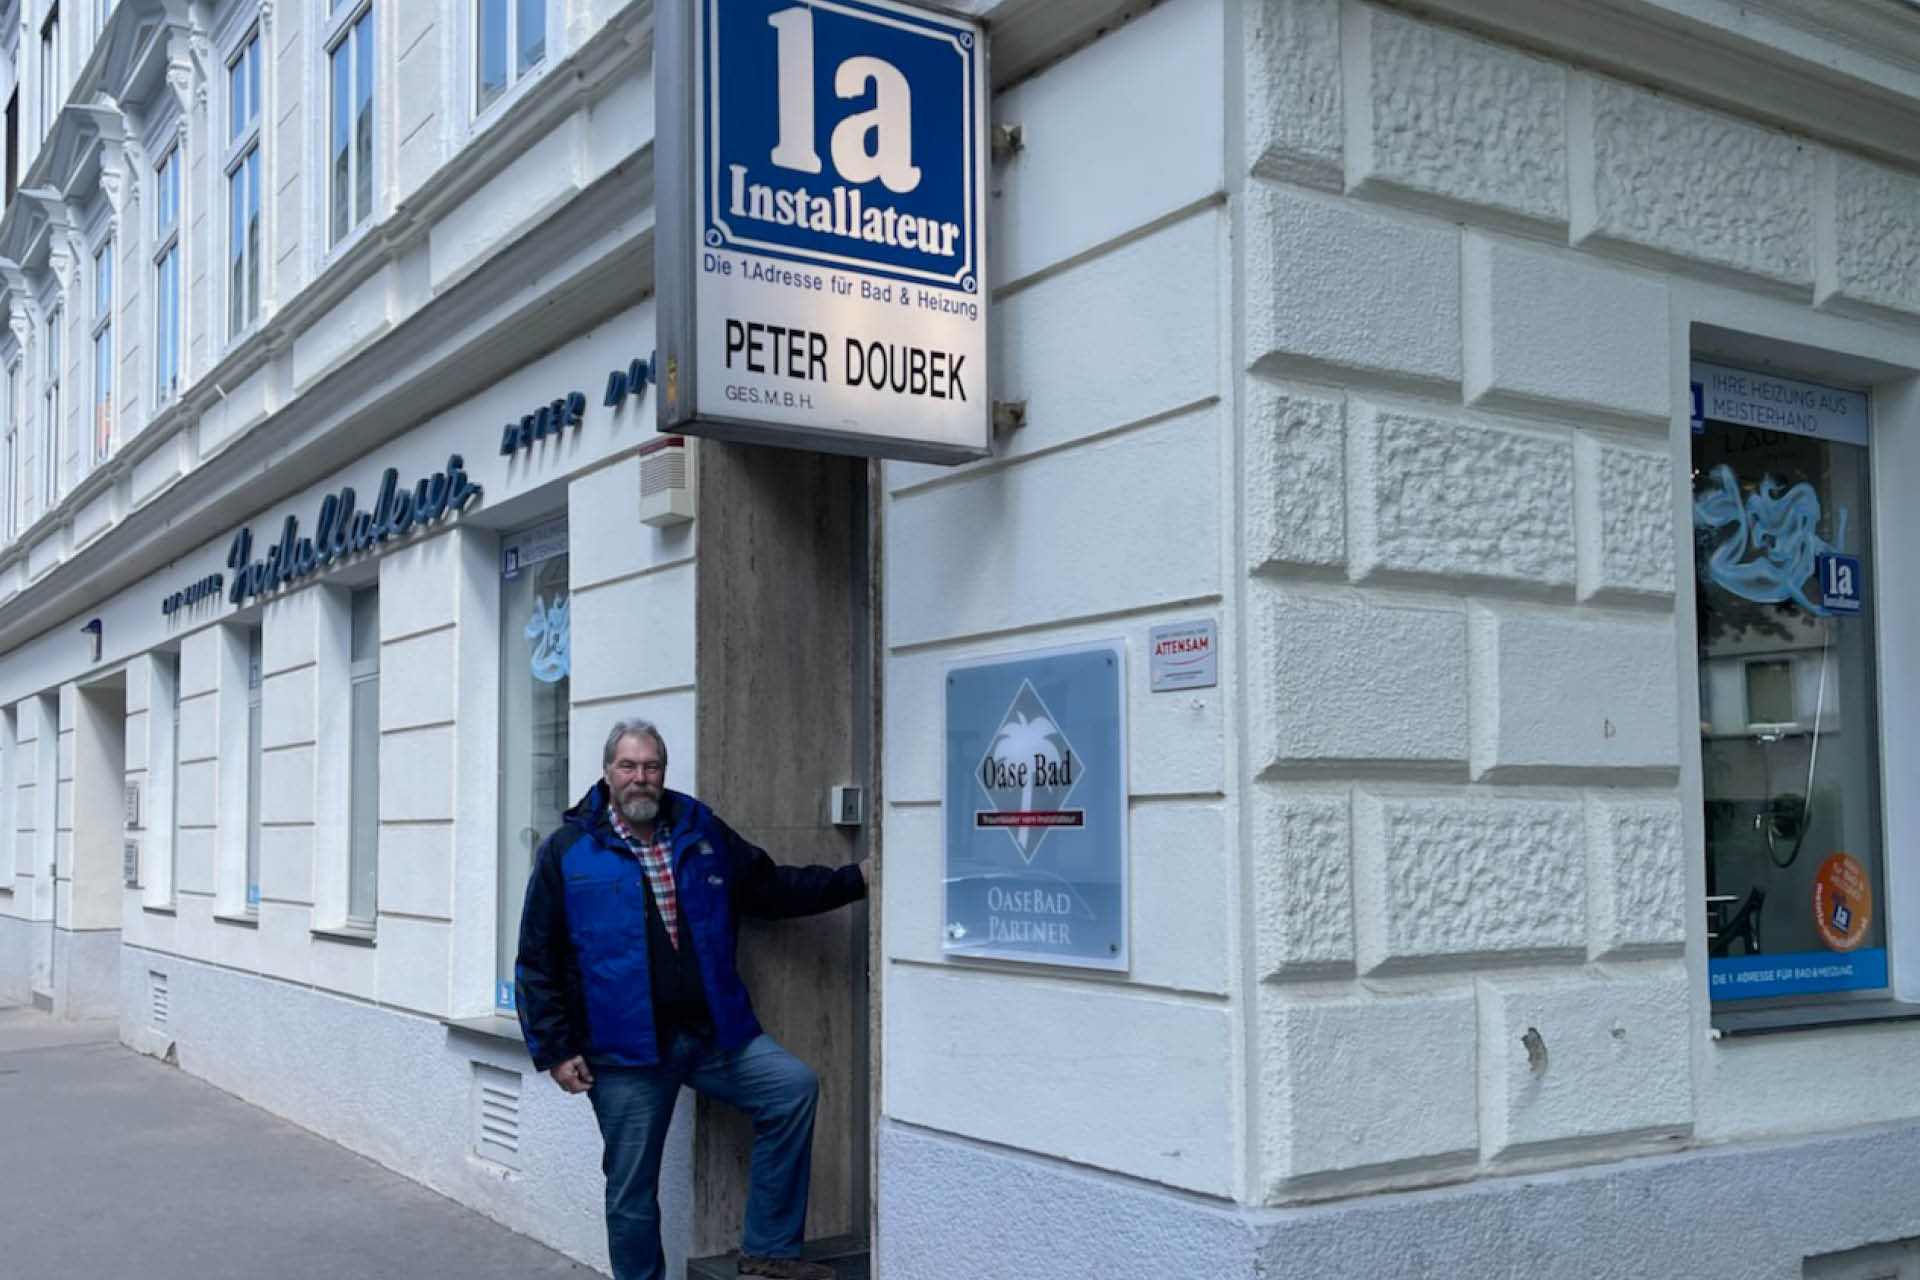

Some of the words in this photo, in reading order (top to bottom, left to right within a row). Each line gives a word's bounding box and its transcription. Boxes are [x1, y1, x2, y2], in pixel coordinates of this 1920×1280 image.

[767, 6, 921, 194] 1a
[728, 163, 960, 258] Installateur
[703, 253, 732, 276] Die
[831, 275, 853, 296] für
[861, 280, 892, 303] Bad
[900, 287, 910, 305] &
[918, 290, 978, 321] Heizung
[725, 318, 828, 383] PETER
[845, 337, 968, 403] DOUBEK
[1712, 375, 1747, 396] IHRE
[1751, 382, 1816, 410] HEIZUNG
[1819, 395, 1849, 416] AUS
[1713, 397, 1818, 433] MEISTERHAND
[1828, 557, 1854, 596] 1a
[1154, 637, 1209, 656] ATTENSAM
[983, 754, 1028, 790] Oase
[1033, 749, 1073, 788] Bad
[987, 915, 1073, 946] PARTNER
[1711, 973, 1727, 986] DIE
[1736, 969, 1775, 983] ADRESSE
